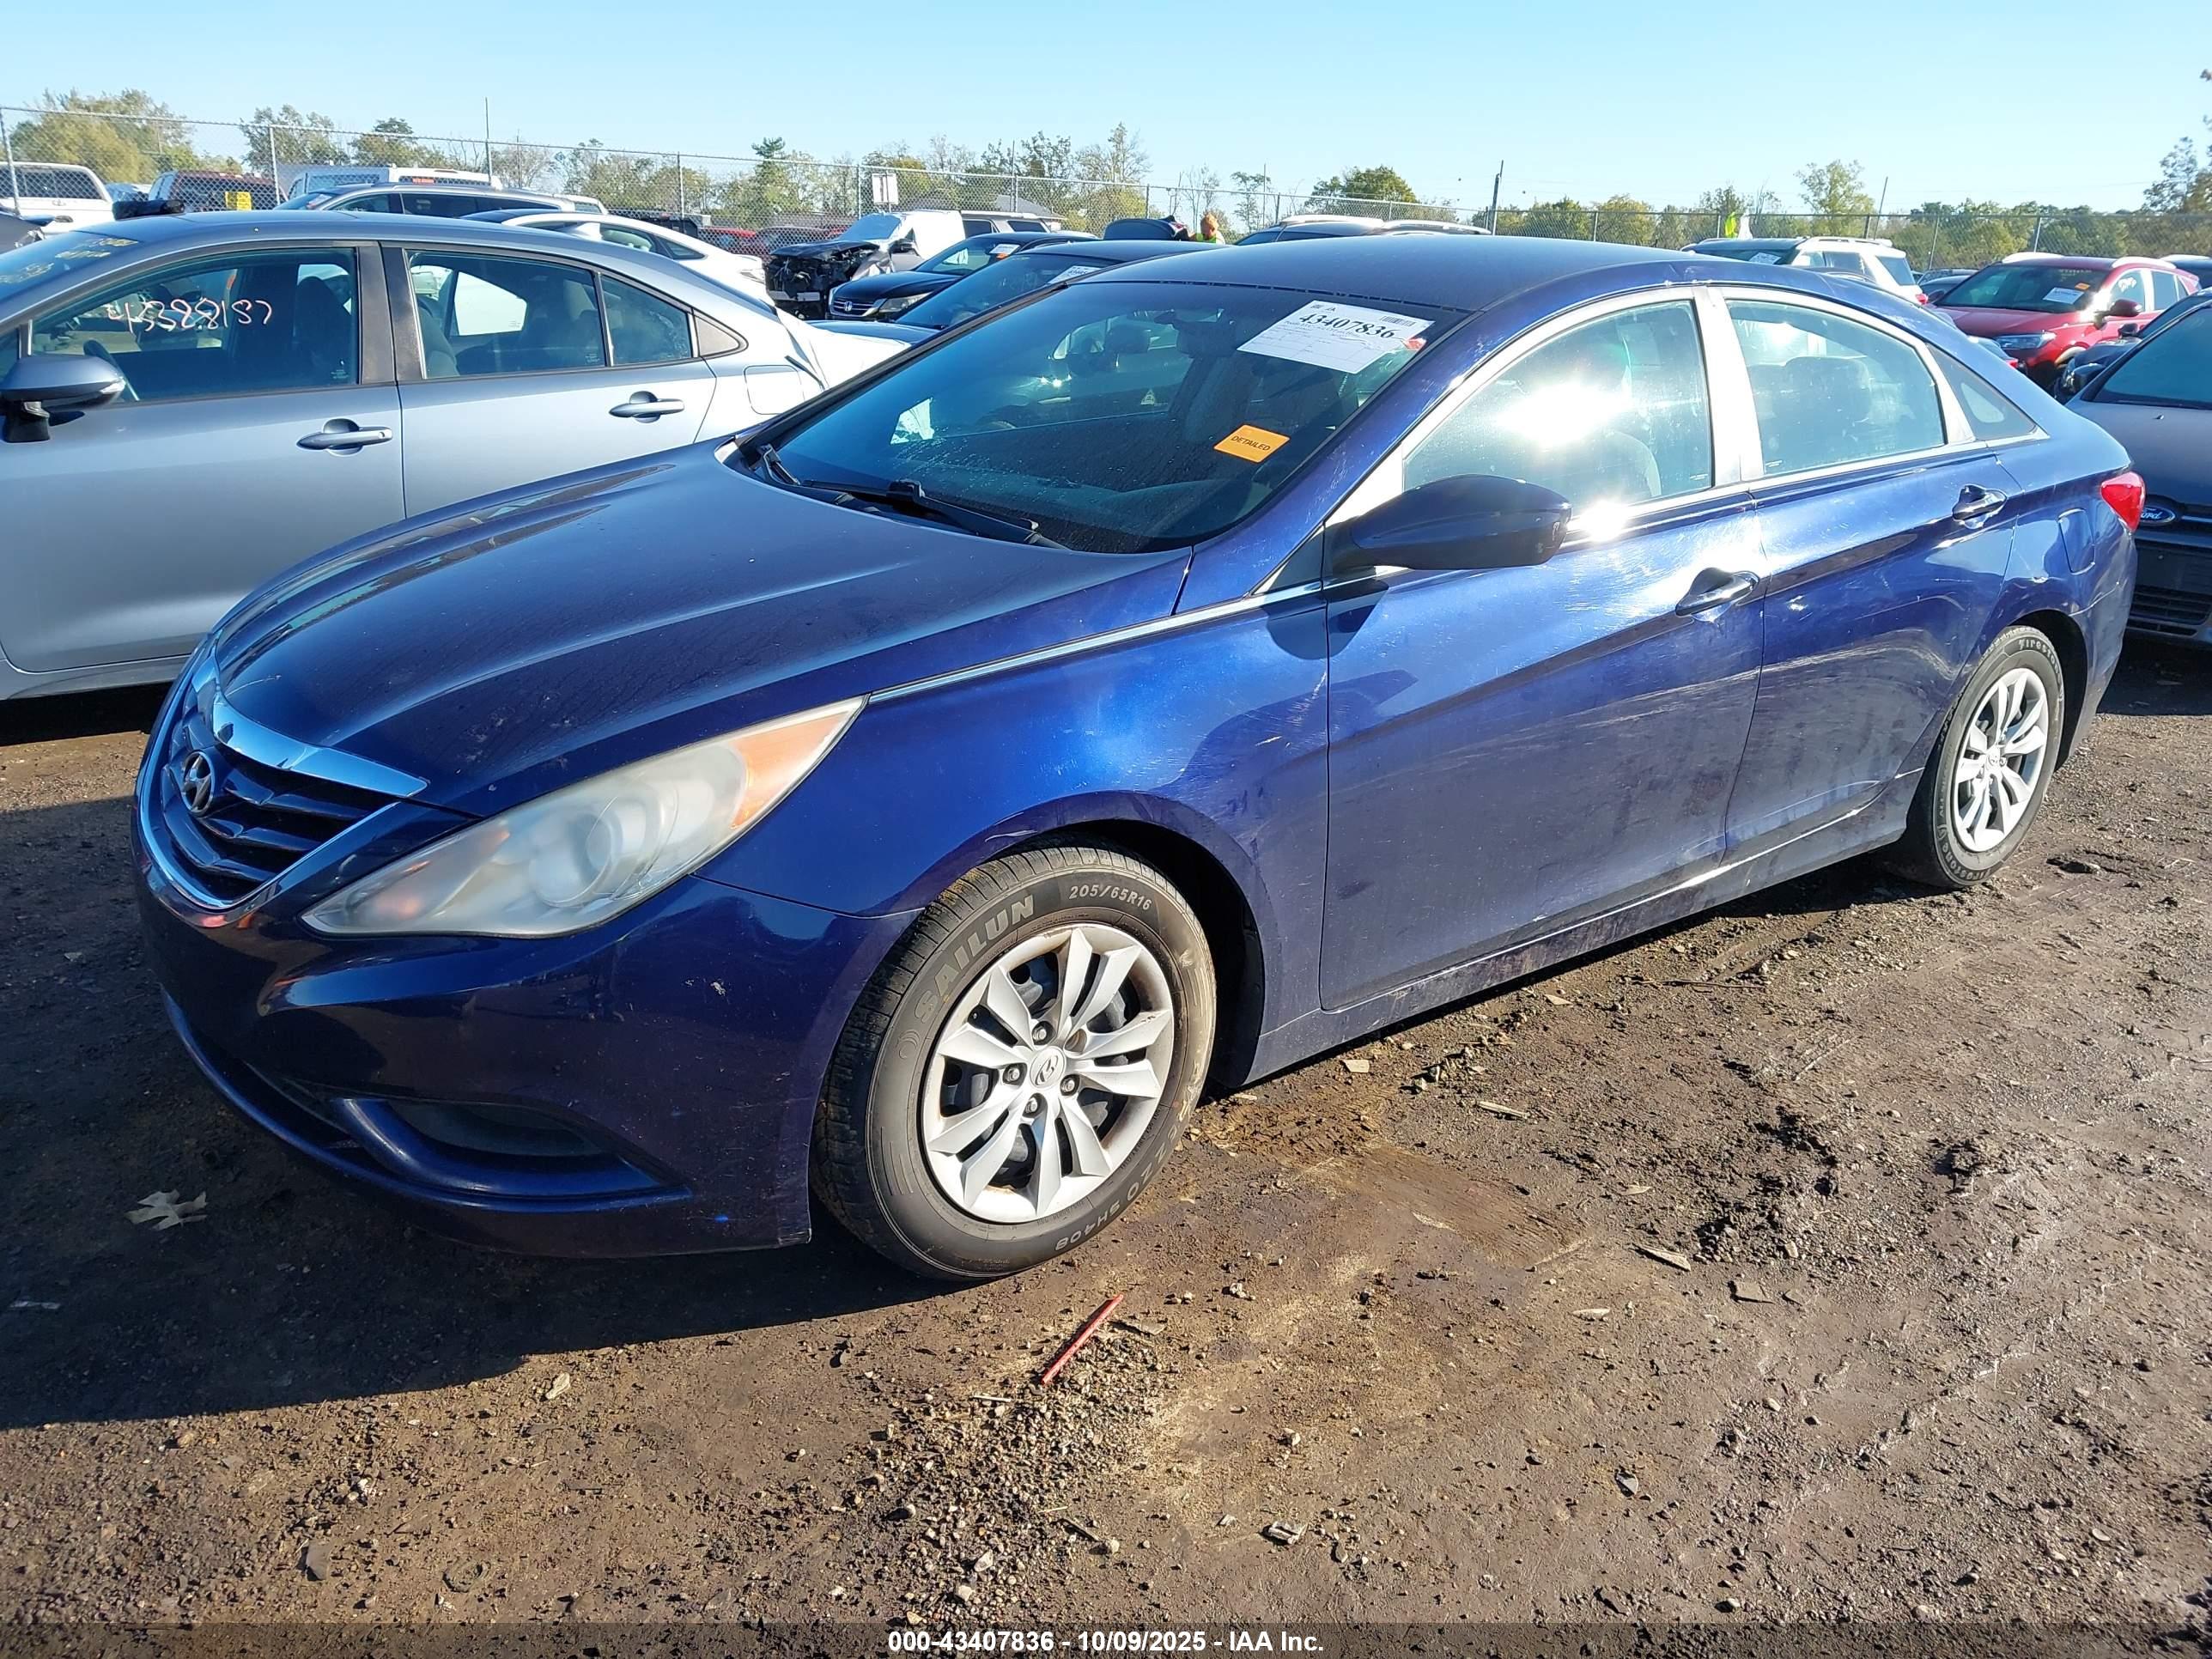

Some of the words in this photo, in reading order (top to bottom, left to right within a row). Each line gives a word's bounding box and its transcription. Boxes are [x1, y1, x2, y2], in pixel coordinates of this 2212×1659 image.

[1299, 313, 1401, 338] 43407836
[1231, 435, 1271, 451] DETAILED
[1068, 884, 1152, 911] 205/65R16
[914, 894, 1035, 1024] SAILUN
[1054, 1200, 1121, 1251] SH408
